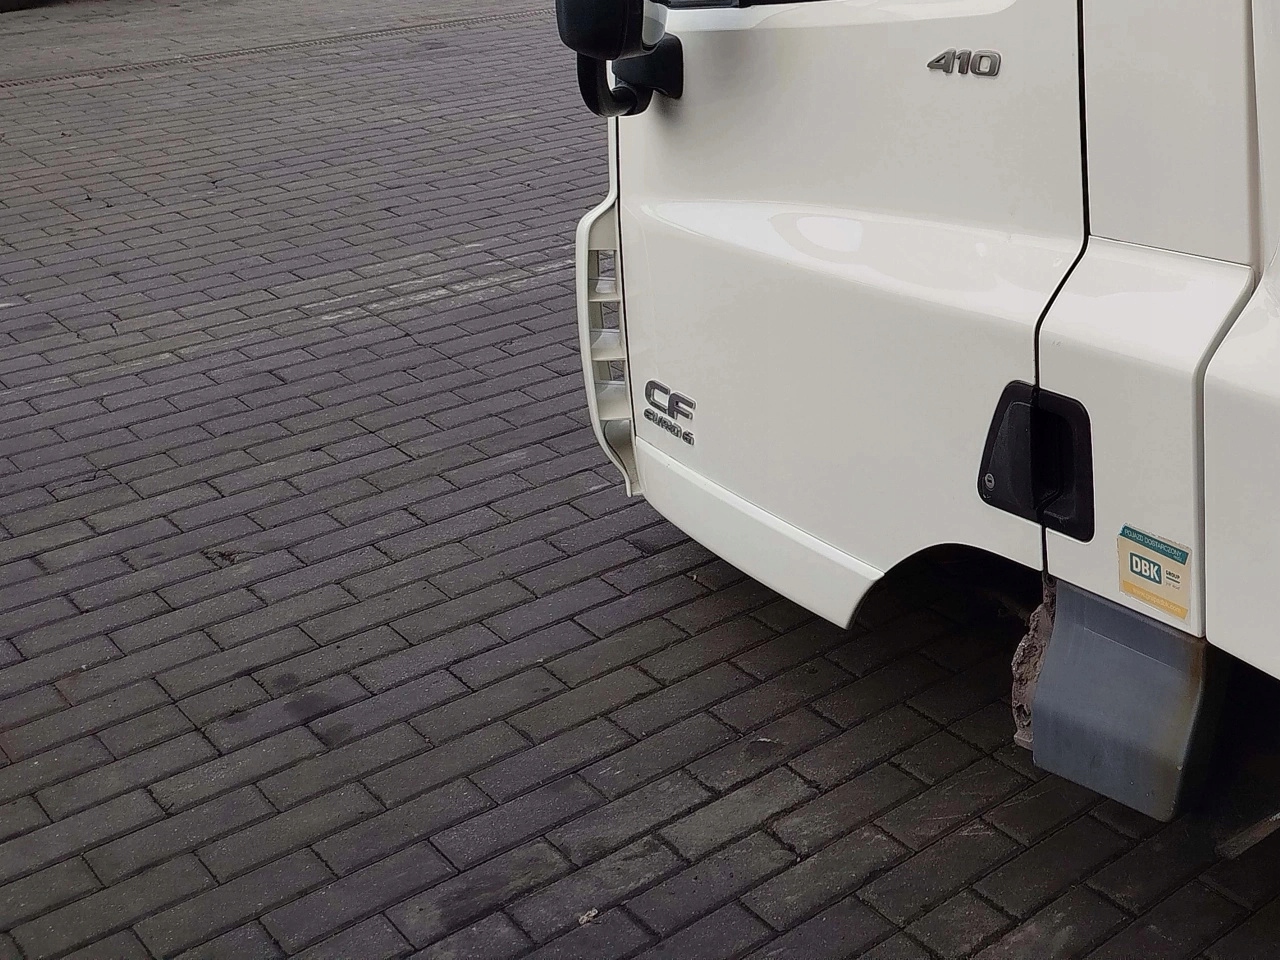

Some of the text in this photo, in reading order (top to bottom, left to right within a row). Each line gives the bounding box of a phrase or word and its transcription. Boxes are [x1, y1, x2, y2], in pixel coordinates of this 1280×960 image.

[926, 47, 1002, 76] 410
[645, 380, 696, 420] CF
[682, 431, 695, 446] 6
[1124, 528, 1182, 557] POJAZD DOSTARCZONY
[1132, 555, 1160, 582] DBK
[1165, 569, 1181, 580] GROUP
